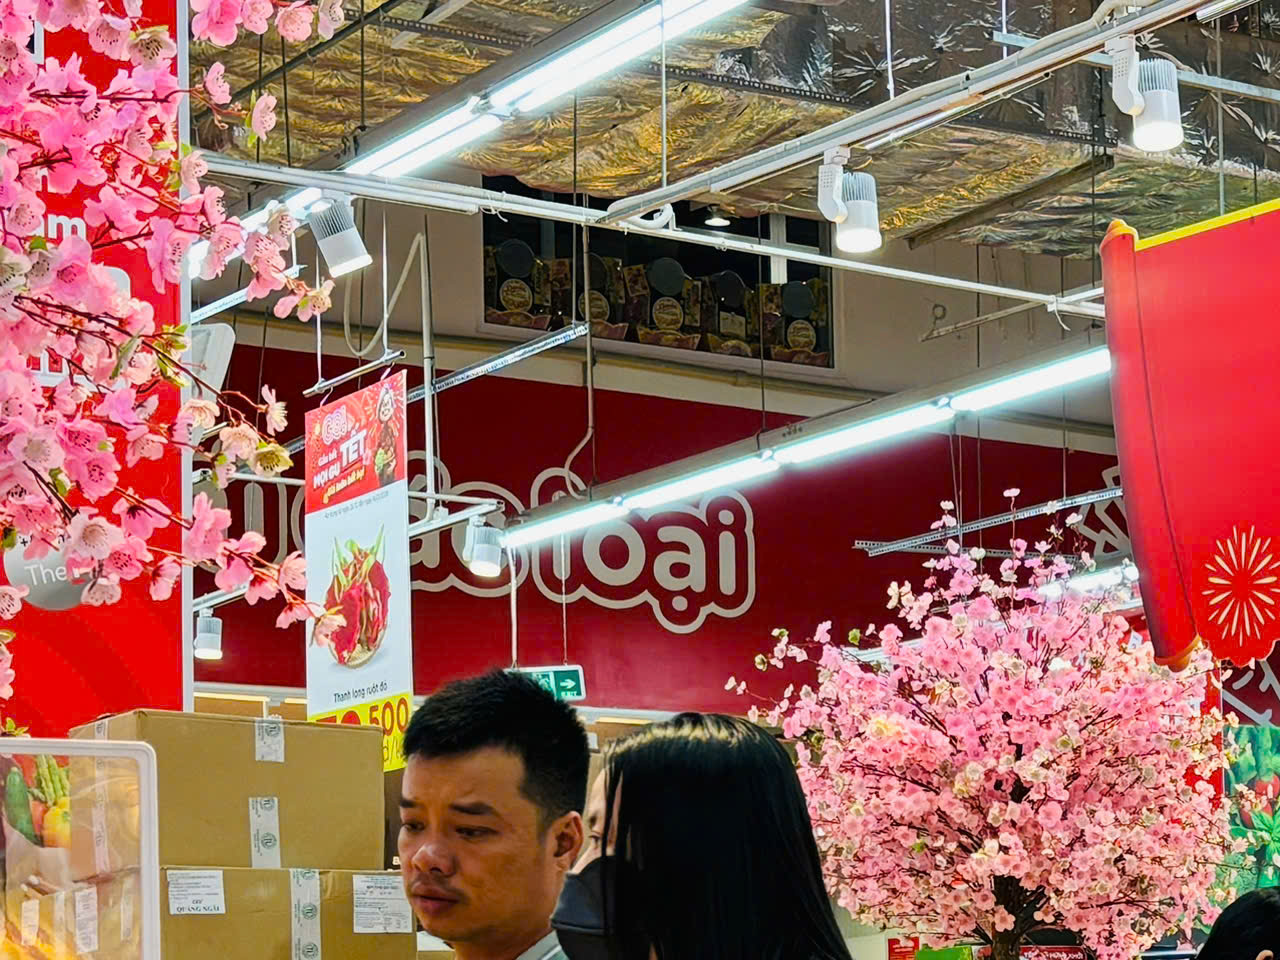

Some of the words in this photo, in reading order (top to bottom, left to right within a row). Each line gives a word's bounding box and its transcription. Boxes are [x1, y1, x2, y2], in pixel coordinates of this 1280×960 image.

[552, 490, 736, 611] loại
[24, 563, 67, 585] The
[333, 688, 351, 703] Thanh
[352, 686, 365, 700] long
